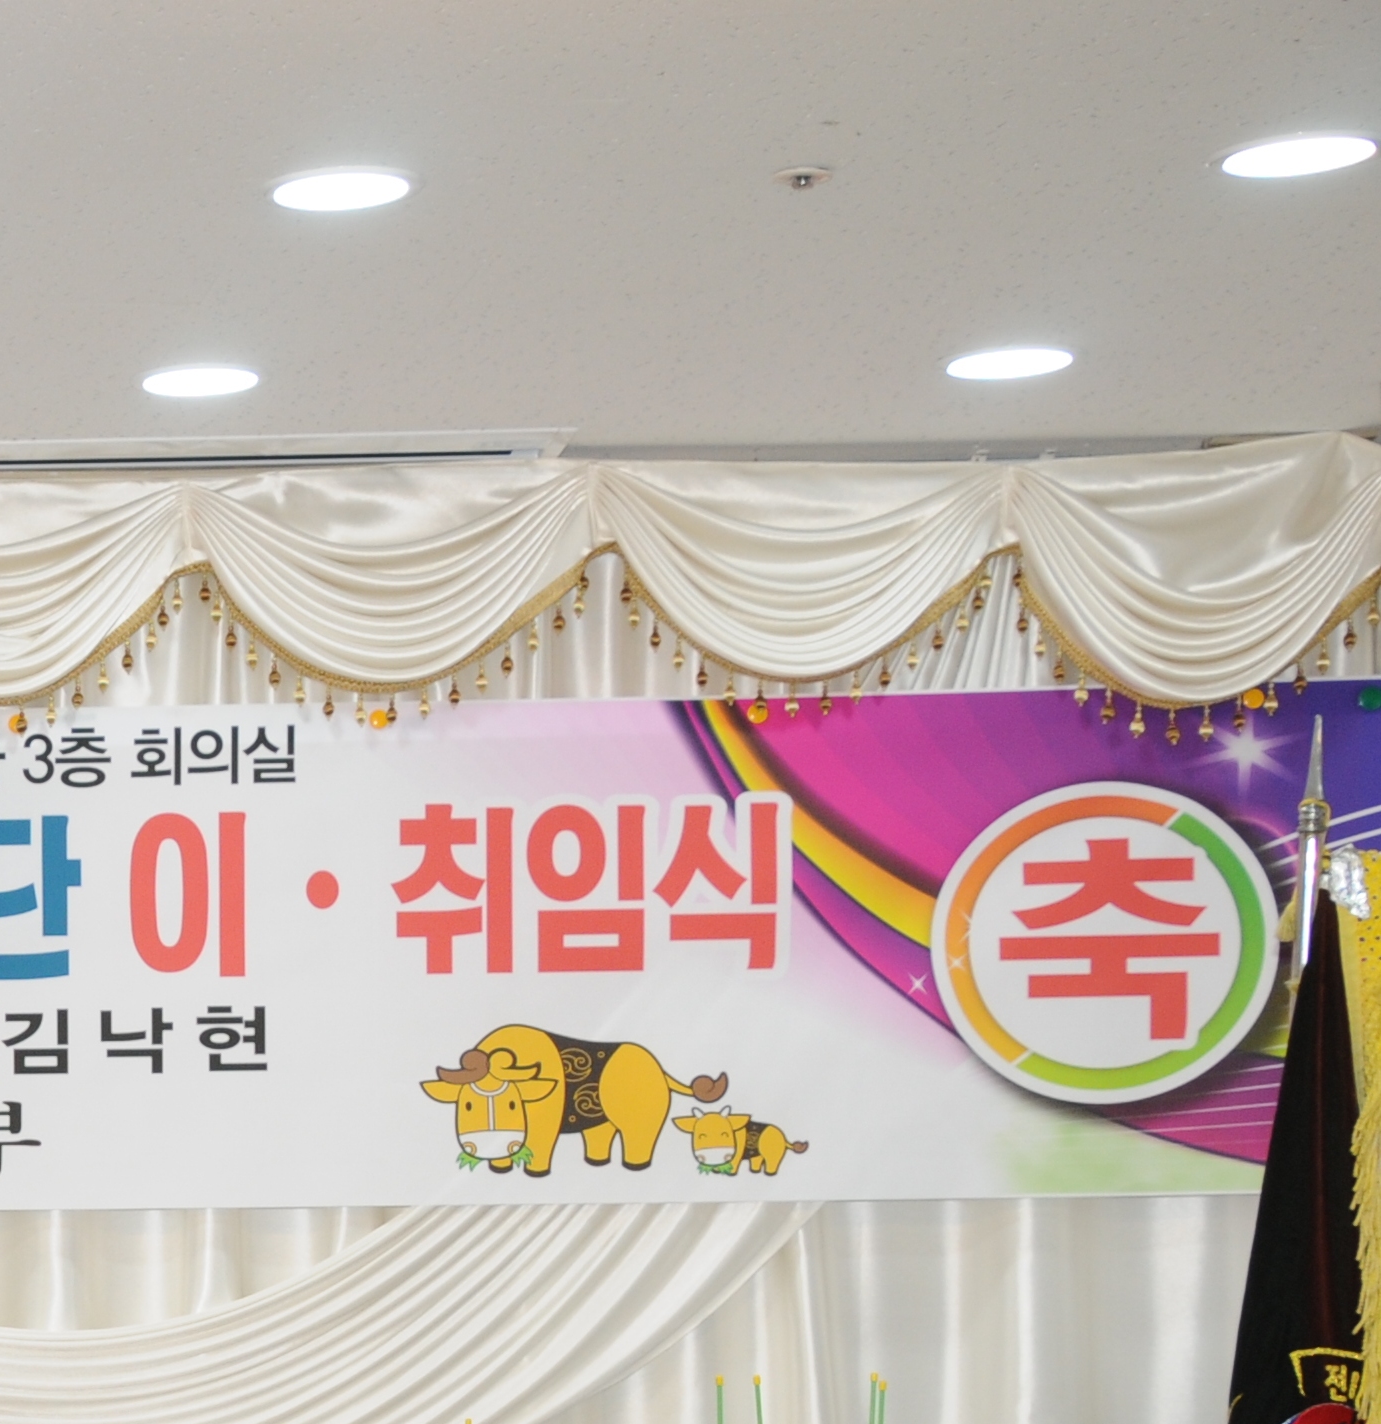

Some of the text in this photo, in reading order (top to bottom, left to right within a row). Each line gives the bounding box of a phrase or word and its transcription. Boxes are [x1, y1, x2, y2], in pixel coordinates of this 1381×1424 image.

[22, 730, 113, 789] 3층
[131, 725, 297, 786] 회의실
[130, 812, 248, 978] 이
[392, 803, 780, 975] 취임식
[999, 838, 1221, 1041] 축
